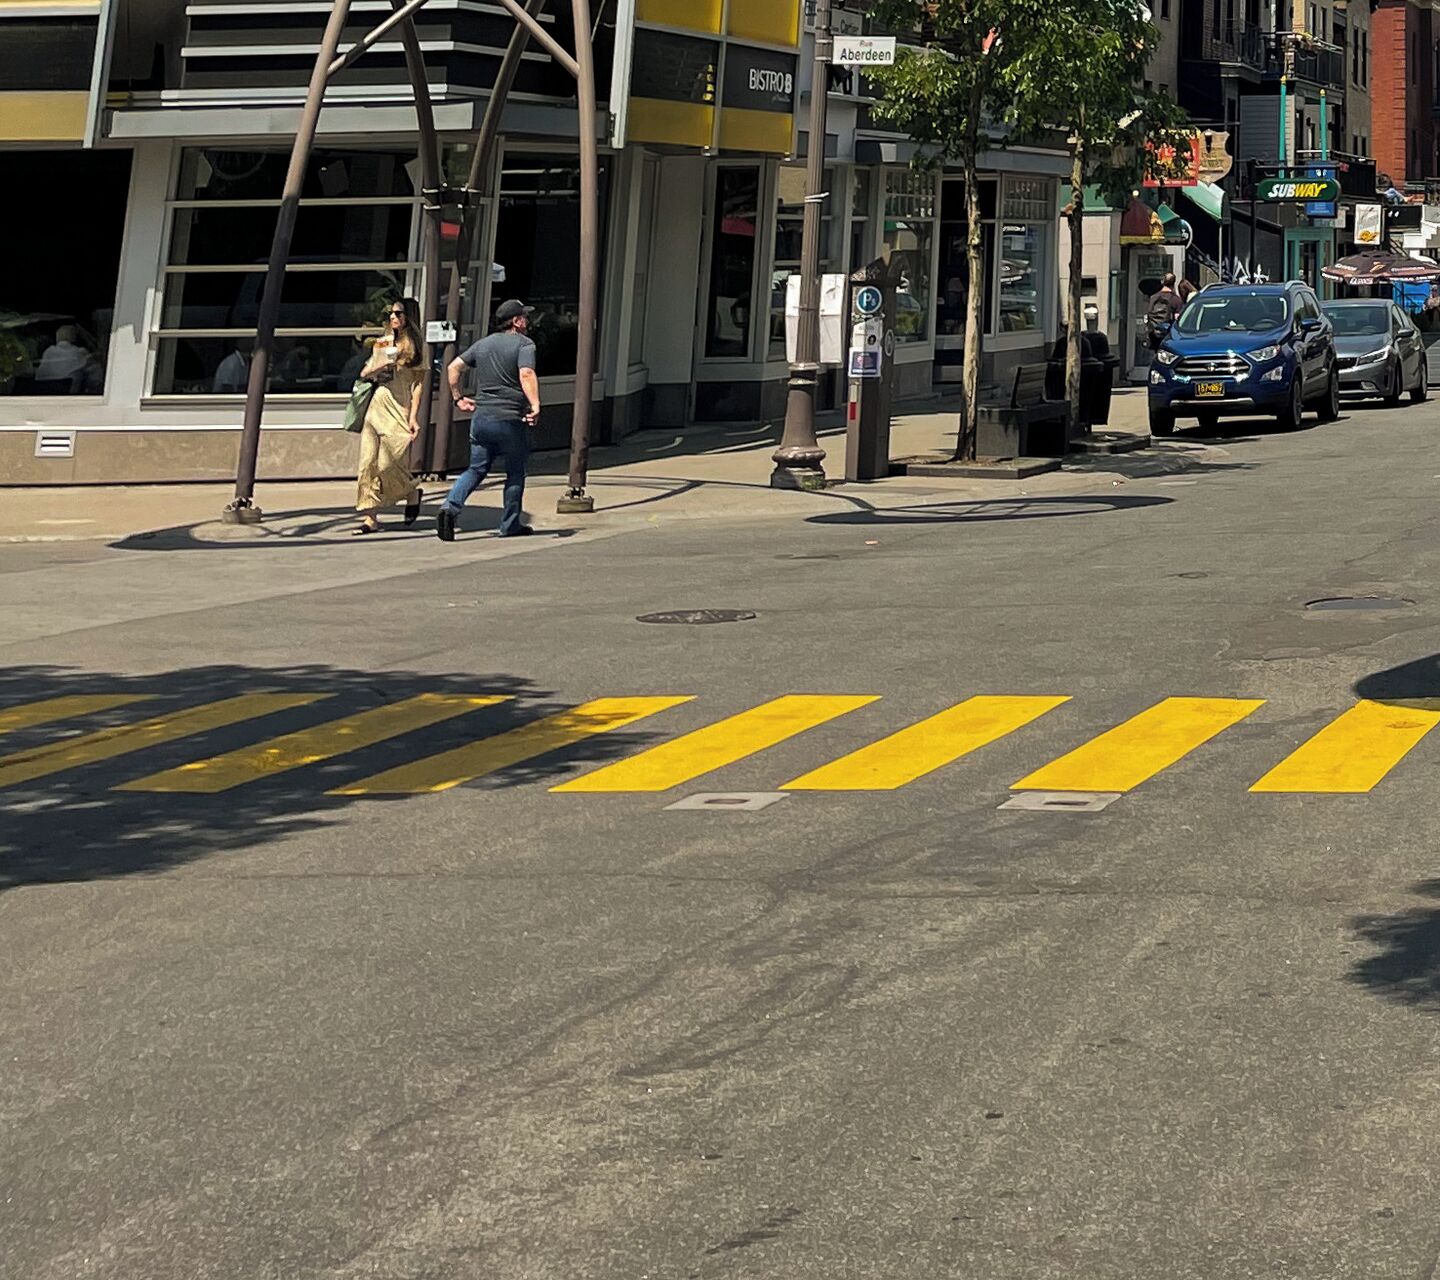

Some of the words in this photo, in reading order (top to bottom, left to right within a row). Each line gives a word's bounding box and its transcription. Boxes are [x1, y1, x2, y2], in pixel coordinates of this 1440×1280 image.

[840, 48, 891, 61] Aberdeen
[749, 68, 784, 92] BISTRO
[784, 74, 792, 94] B
[1268, 183, 1327, 198] SUBWAY
